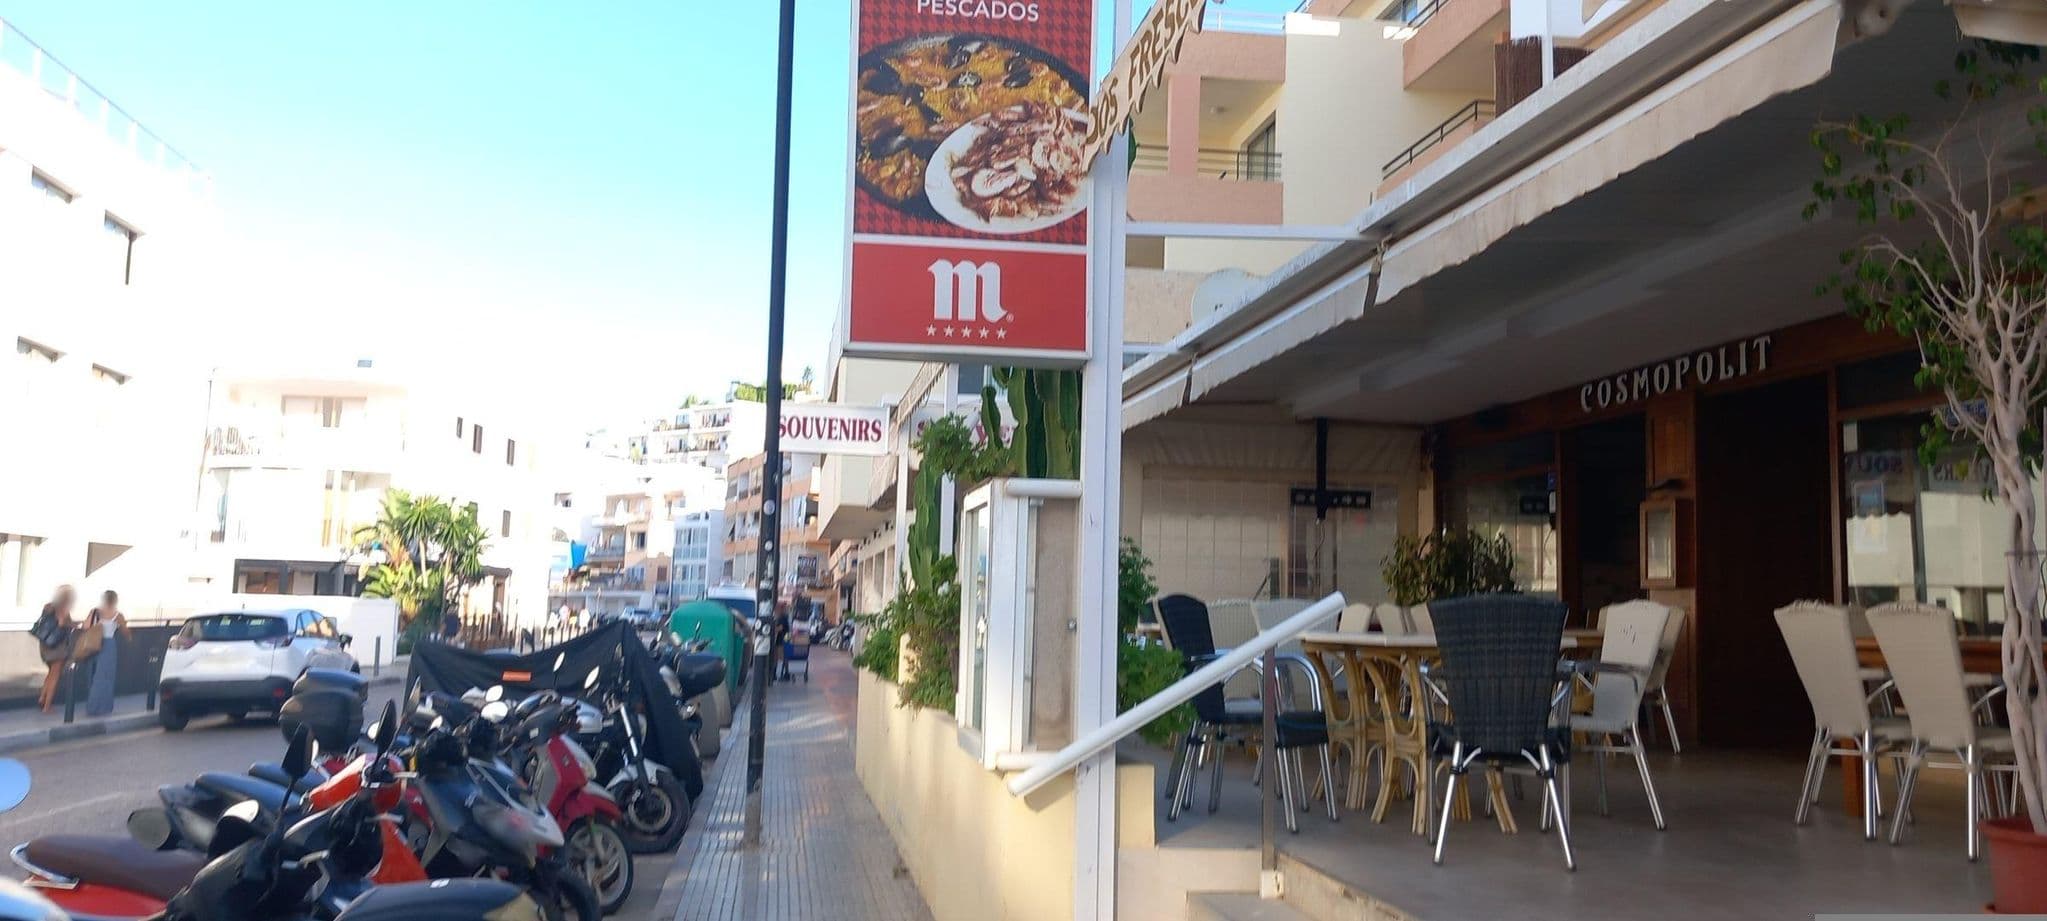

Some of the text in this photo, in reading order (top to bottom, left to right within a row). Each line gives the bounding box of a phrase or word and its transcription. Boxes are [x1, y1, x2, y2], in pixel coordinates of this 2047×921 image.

[917, 0, 1039, 22] PESCADOS
[1580, 335, 1772, 413] COSMOPOLIT
[779, 415, 882, 442] SOUVENIRS
